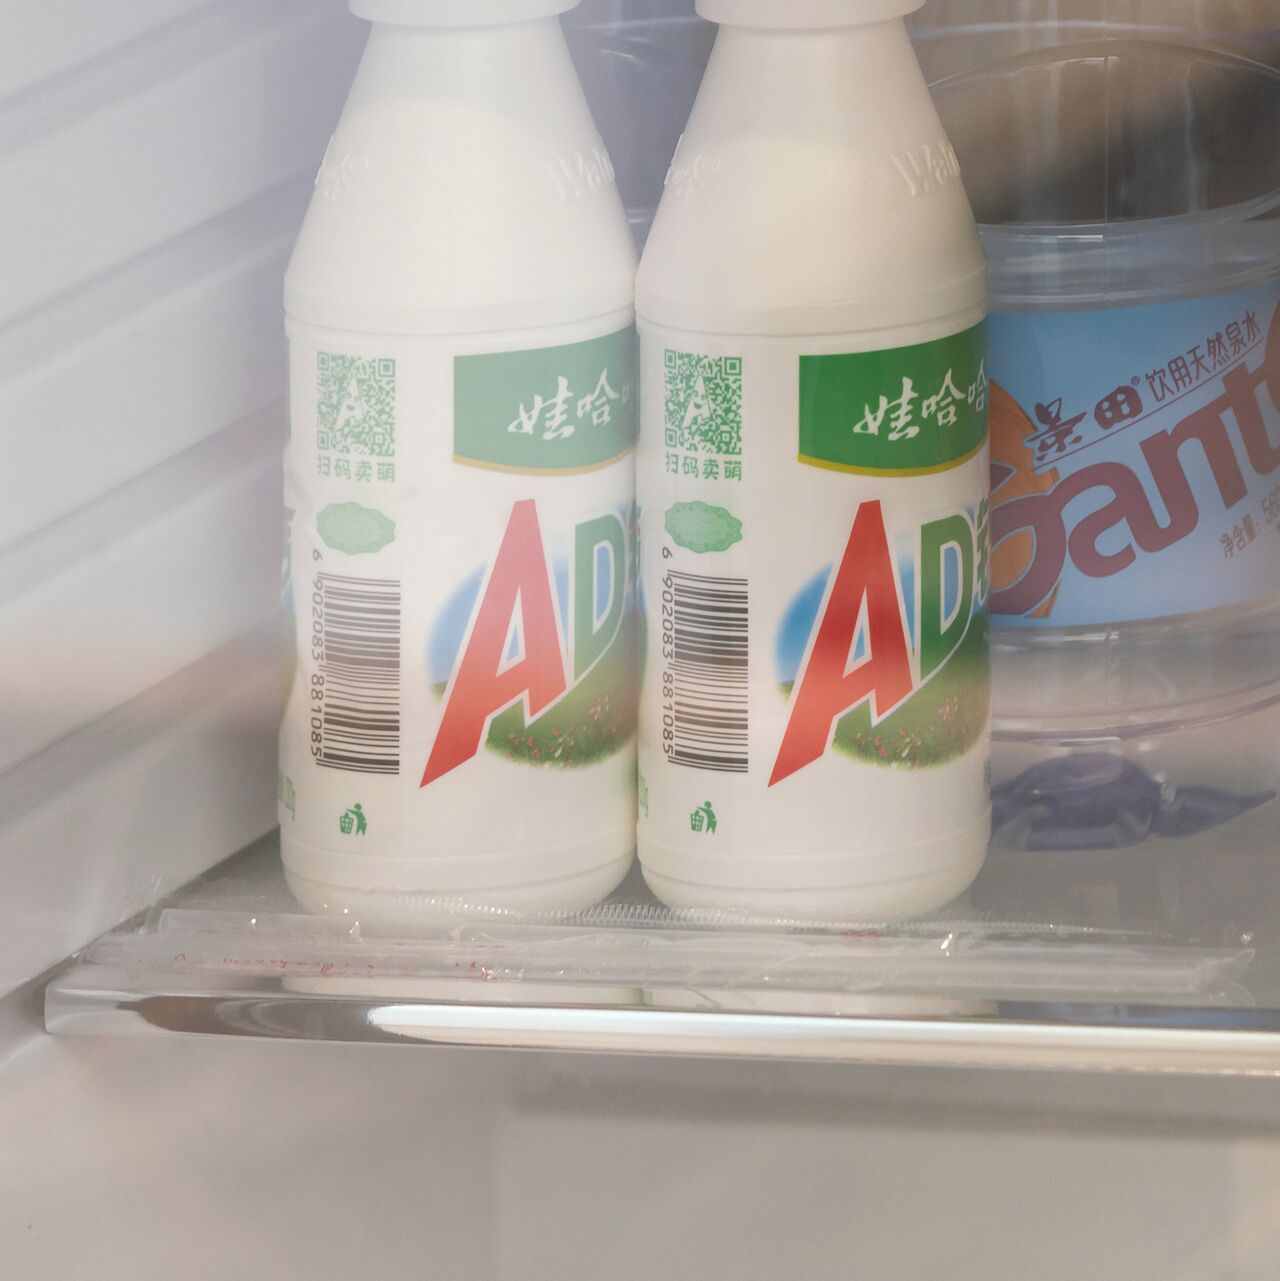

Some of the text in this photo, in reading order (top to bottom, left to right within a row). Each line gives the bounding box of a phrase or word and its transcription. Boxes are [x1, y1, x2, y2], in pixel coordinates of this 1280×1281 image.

[507, 368, 631, 441] 娃哈
[1025, 309, 1266, 462] 景田 饮用天然泉水
[316, 454, 396, 483] 扫码卖萌
[664, 451, 742, 481] 扫码卖萌
[662, 546, 675, 757] 6 902083 881085
[310, 673, 325, 759] 881085
